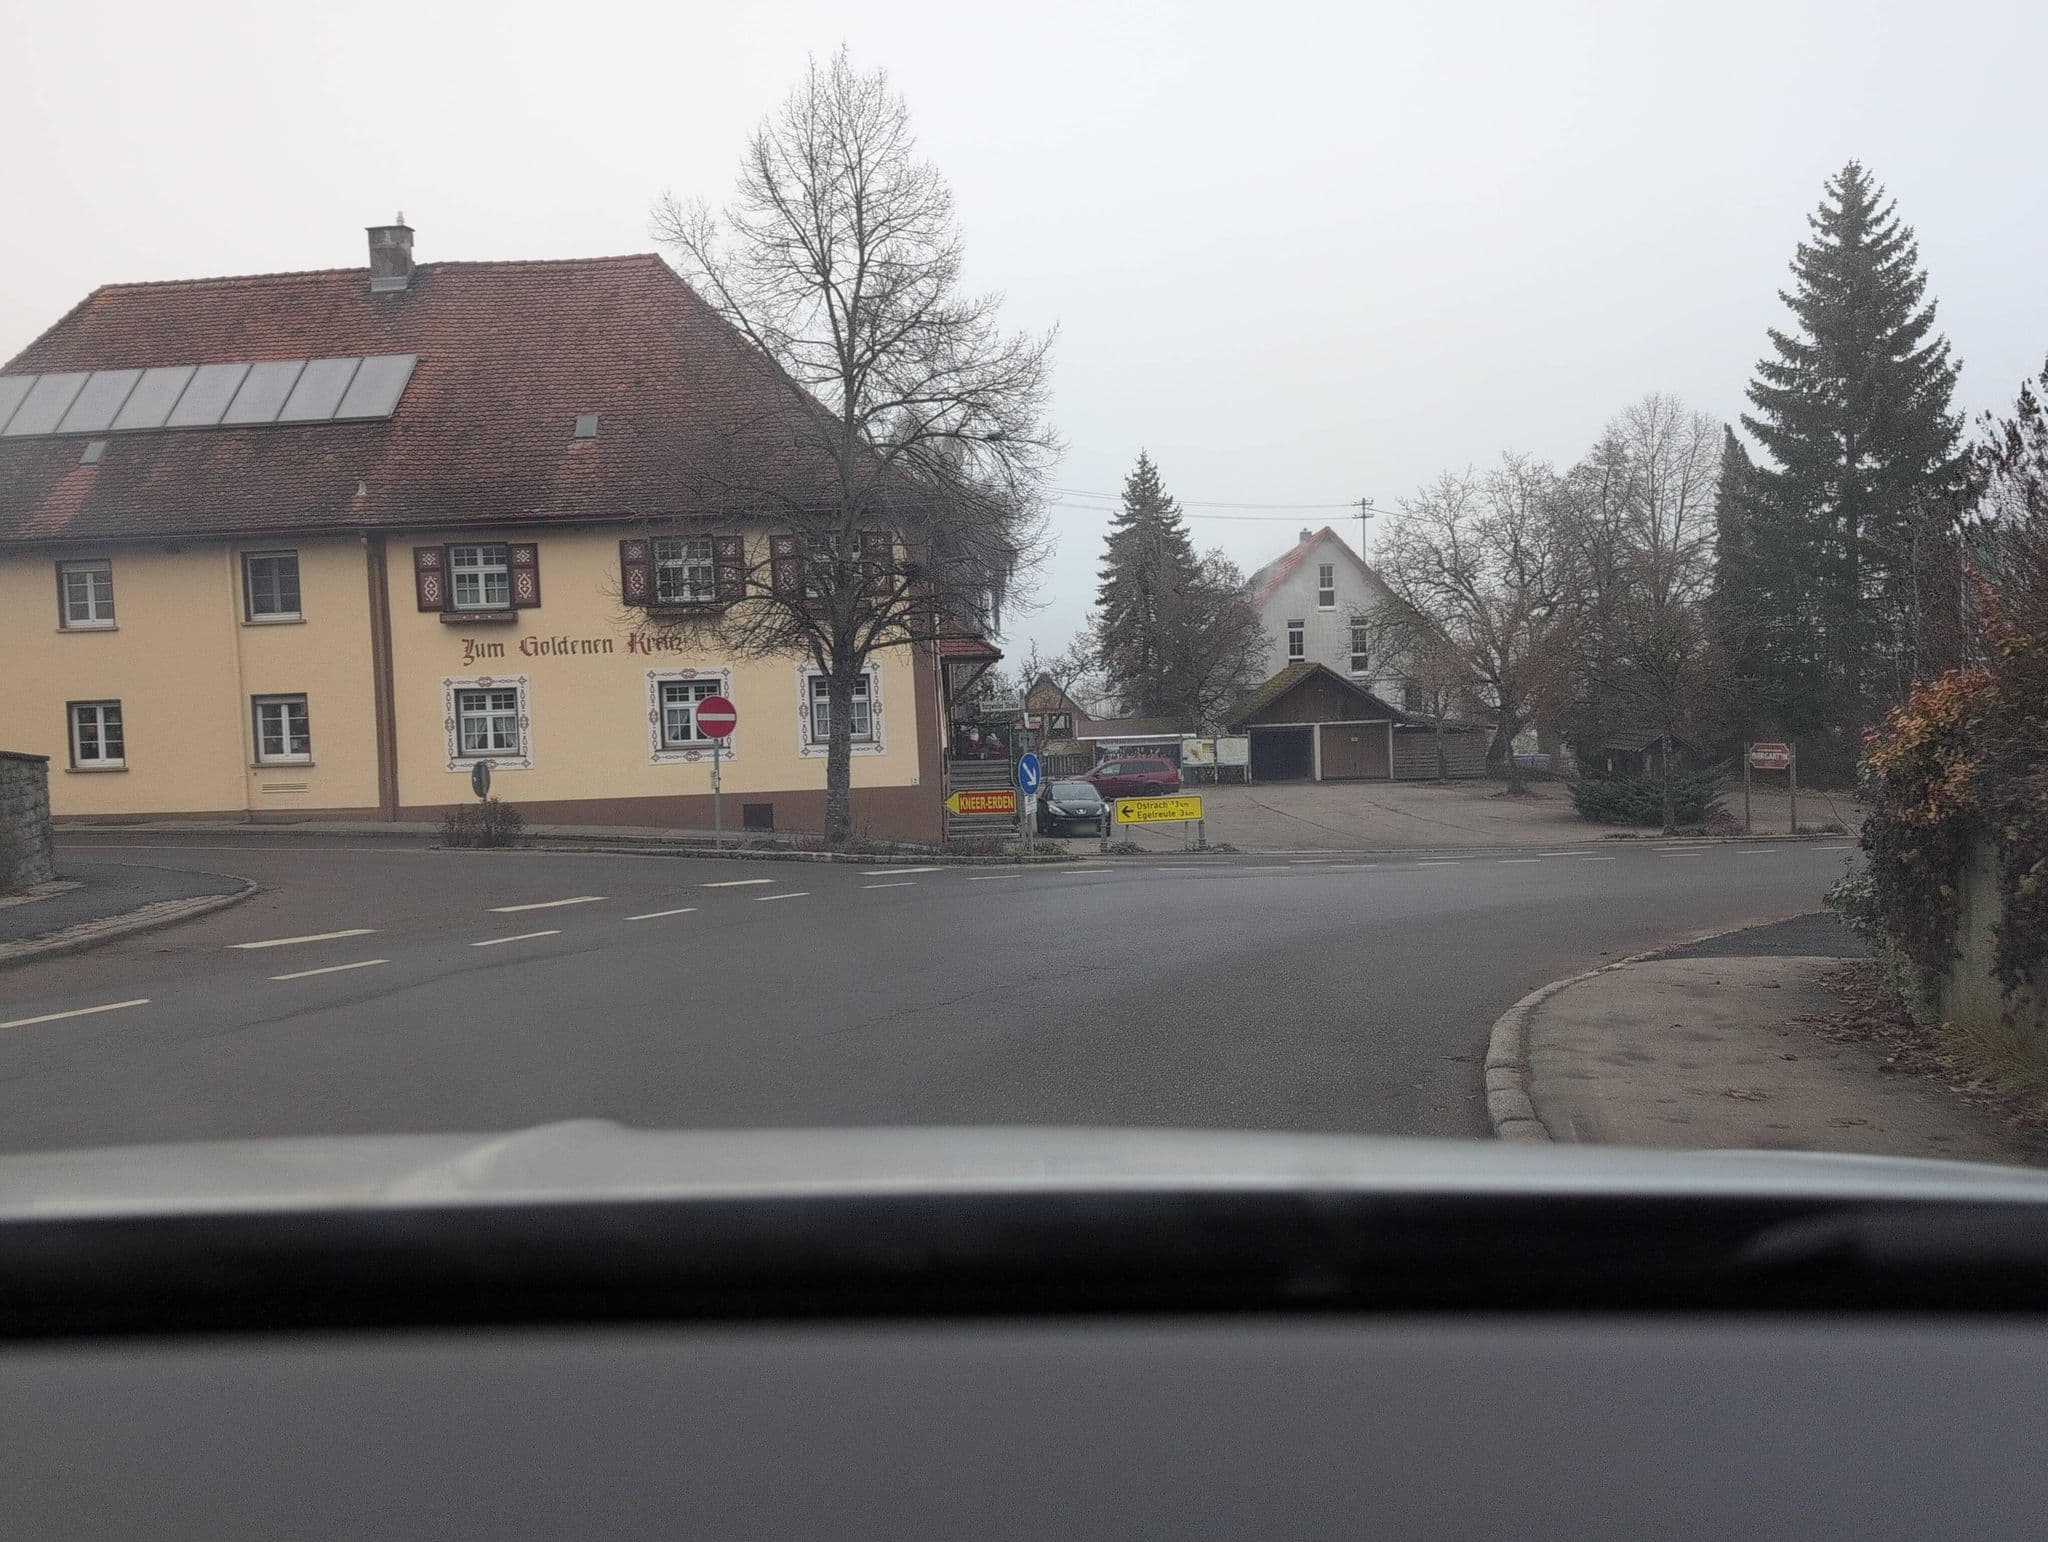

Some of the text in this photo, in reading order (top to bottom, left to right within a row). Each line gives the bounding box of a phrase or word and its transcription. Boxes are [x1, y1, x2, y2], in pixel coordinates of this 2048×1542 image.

[462, 638, 506, 666] Zum
[519, 635, 614, 657] Goldenen
[959, 795, 1014, 810] KNEER-ERDEN
[1136, 801, 1168, 810] Ostrach
[1137, 809, 1175, 820] Egelreute
